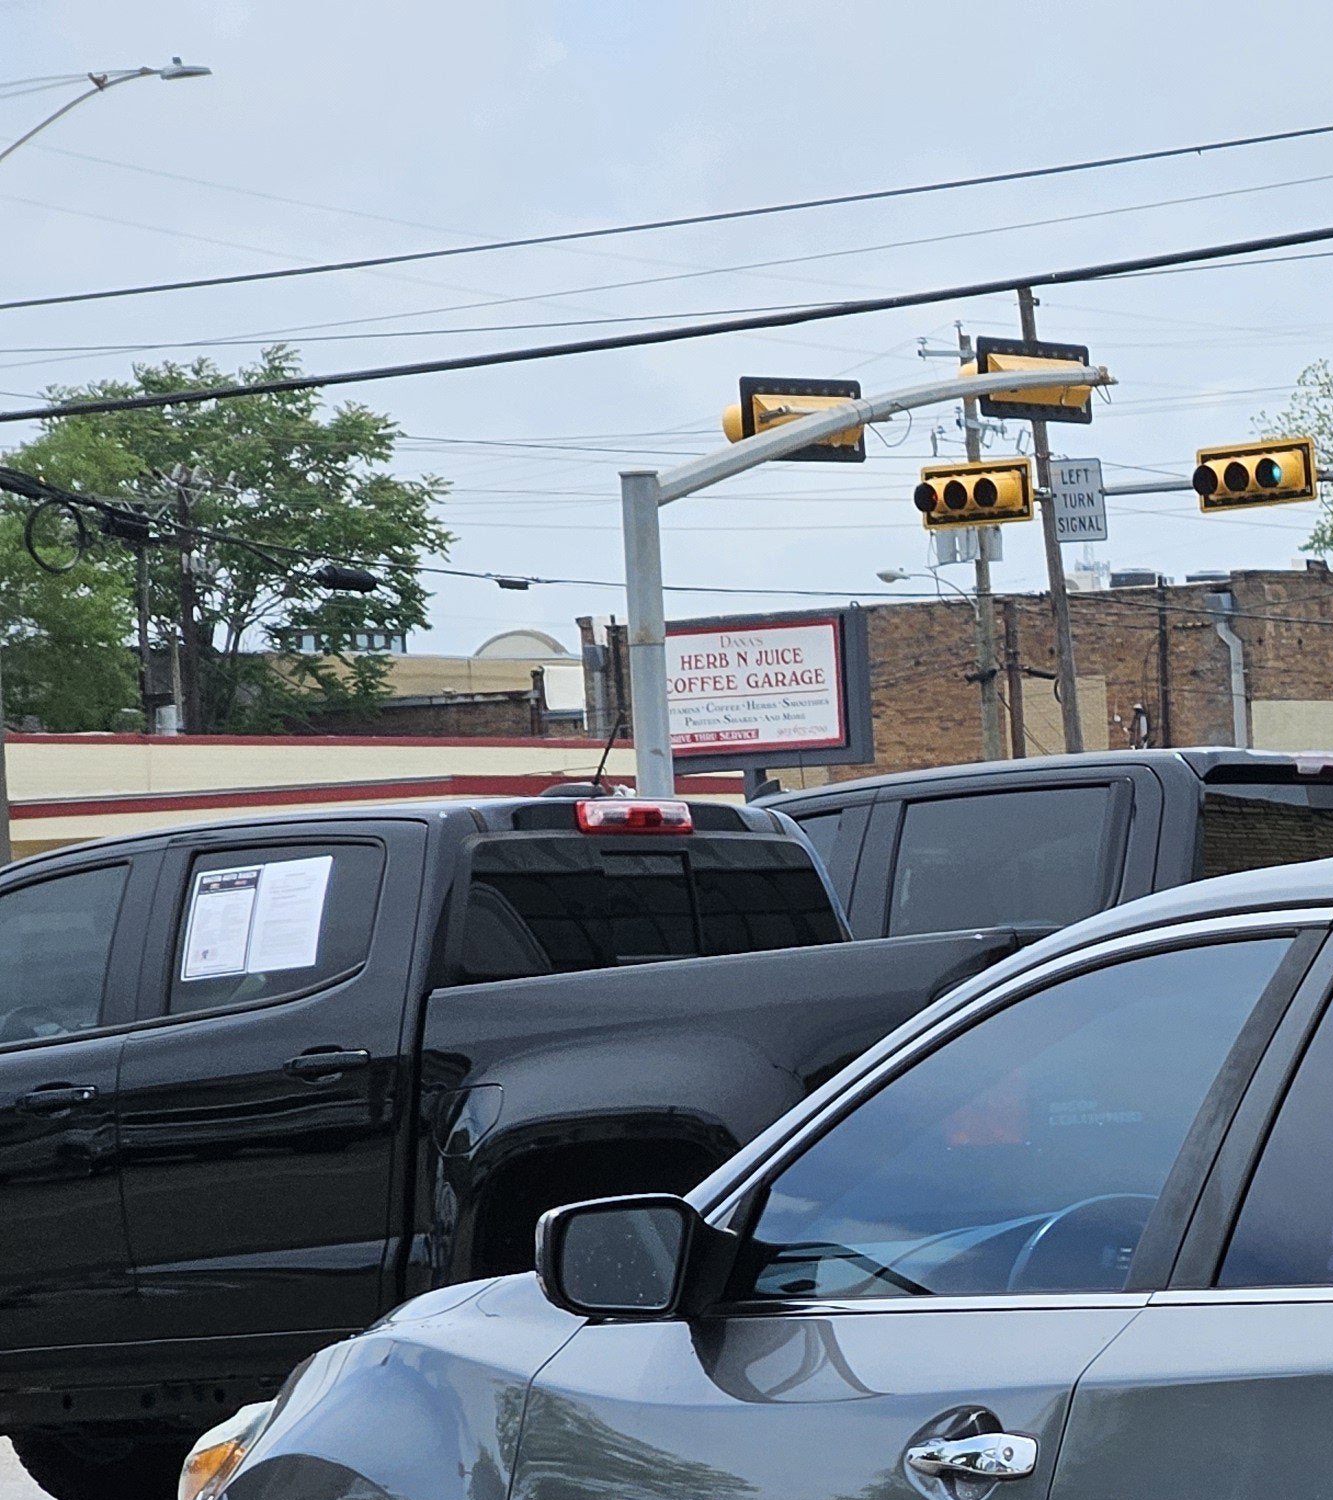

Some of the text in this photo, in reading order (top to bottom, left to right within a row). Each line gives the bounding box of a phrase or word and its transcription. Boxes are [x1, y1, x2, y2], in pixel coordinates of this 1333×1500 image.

[1061, 468, 1089, 485] LEFT
[1062, 492, 1095, 508] TURN
[1058, 515, 1103, 533] SIGNAL
[680, 648, 804, 671] HERB N JUICE
[746, 668, 825, 689] GARAGE
[719, 730, 757, 741] SERVICE
